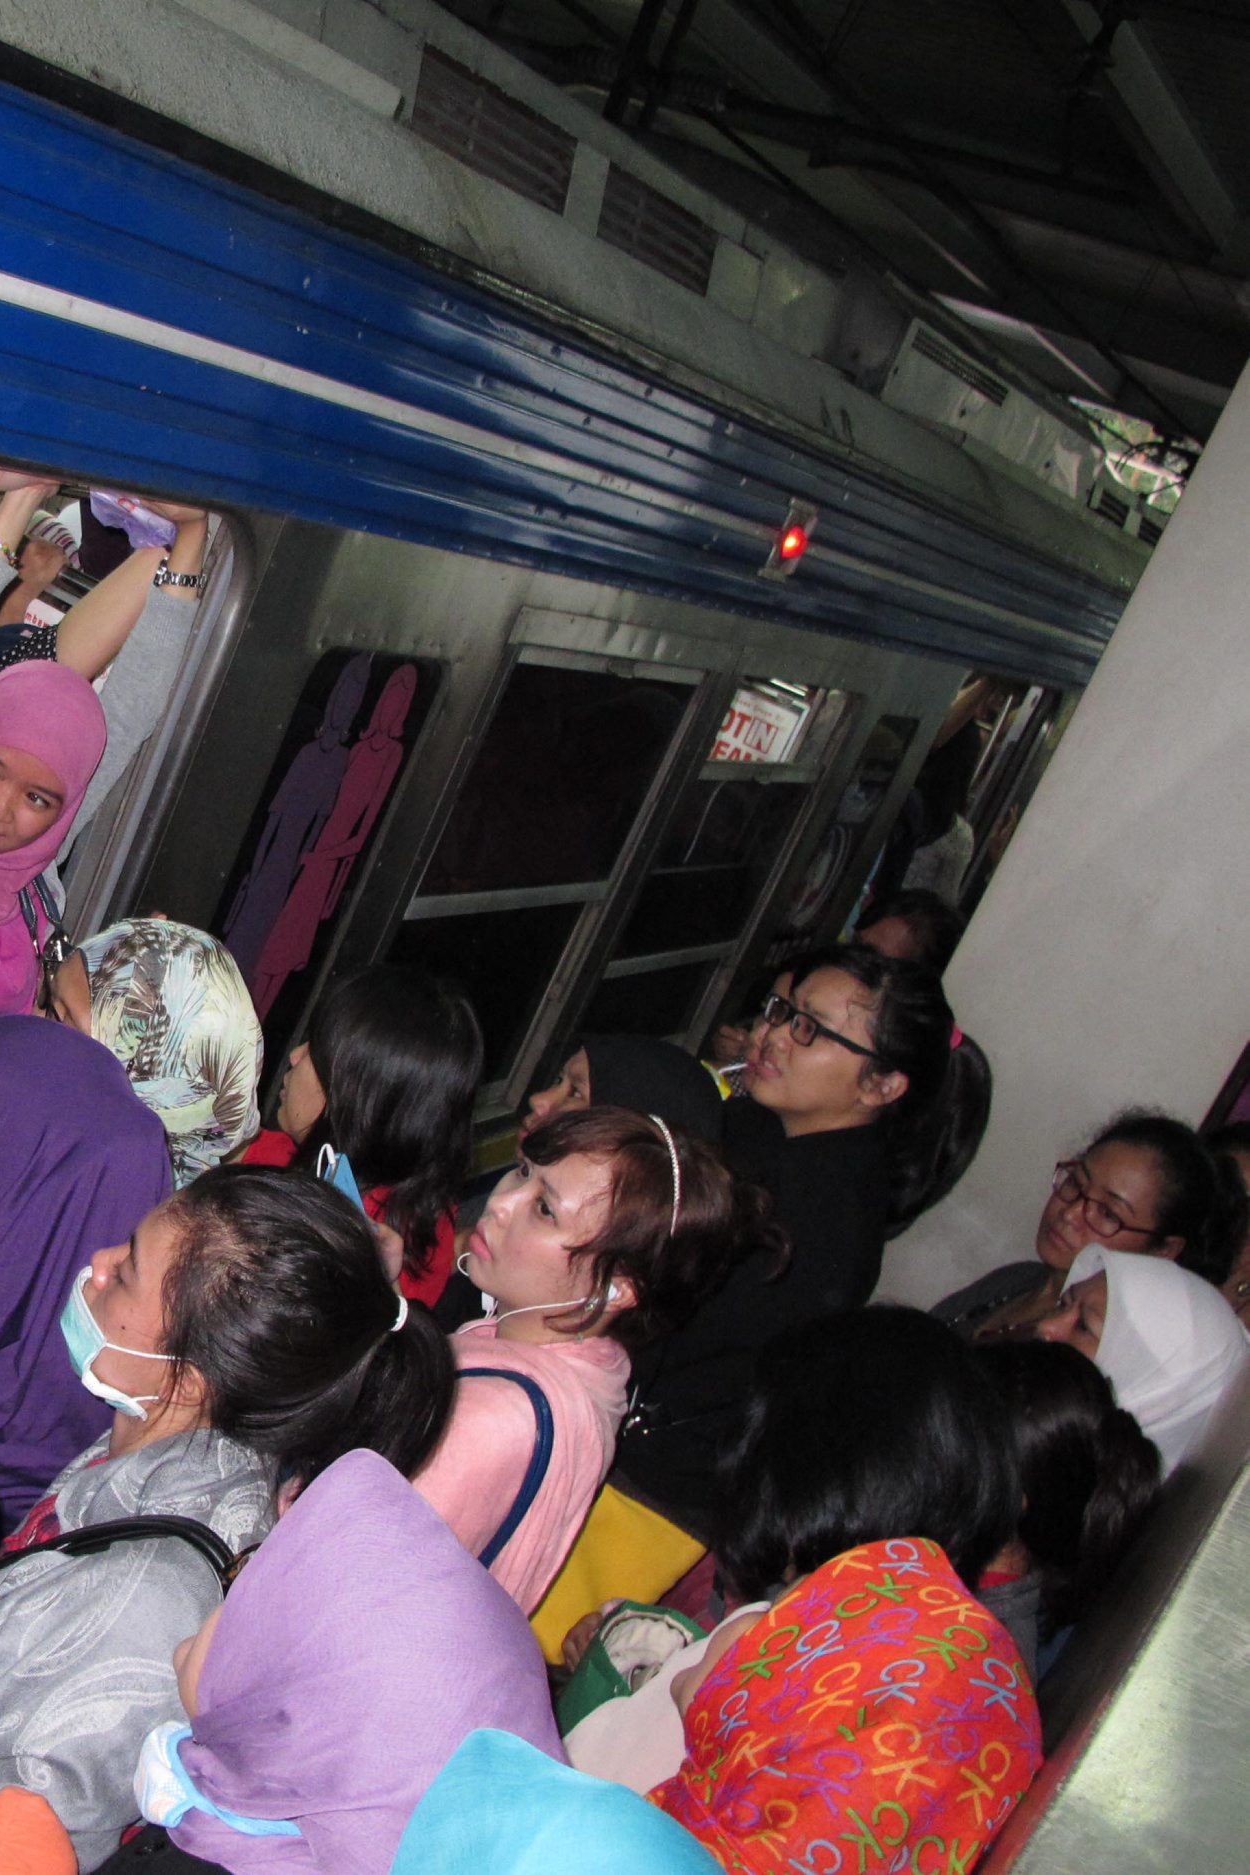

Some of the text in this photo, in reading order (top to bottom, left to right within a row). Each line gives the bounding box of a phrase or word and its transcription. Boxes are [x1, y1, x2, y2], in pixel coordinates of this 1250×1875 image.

[878, 1539, 930, 1576] CK
[835, 1572, 914, 1618] CK
[918, 1585, 992, 1624] CK
[738, 1625, 800, 1686] CK
[785, 1620, 845, 1673] CK
[847, 1607, 919, 1655] CK
[914, 1625, 989, 1672] CK
[796, 1661, 862, 1723] CK
[862, 1659, 927, 1707] CK
[969, 1657, 1018, 1722] CK
[714, 1689, 750, 1741] CK
[931, 1695, 990, 1761] CK
[790, 1749, 863, 1818] CK
[871, 1722, 937, 1796] CK
[955, 1741, 1011, 1826] CK
[743, 1799, 797, 1862] CK
[839, 1800, 910, 1874] CK
